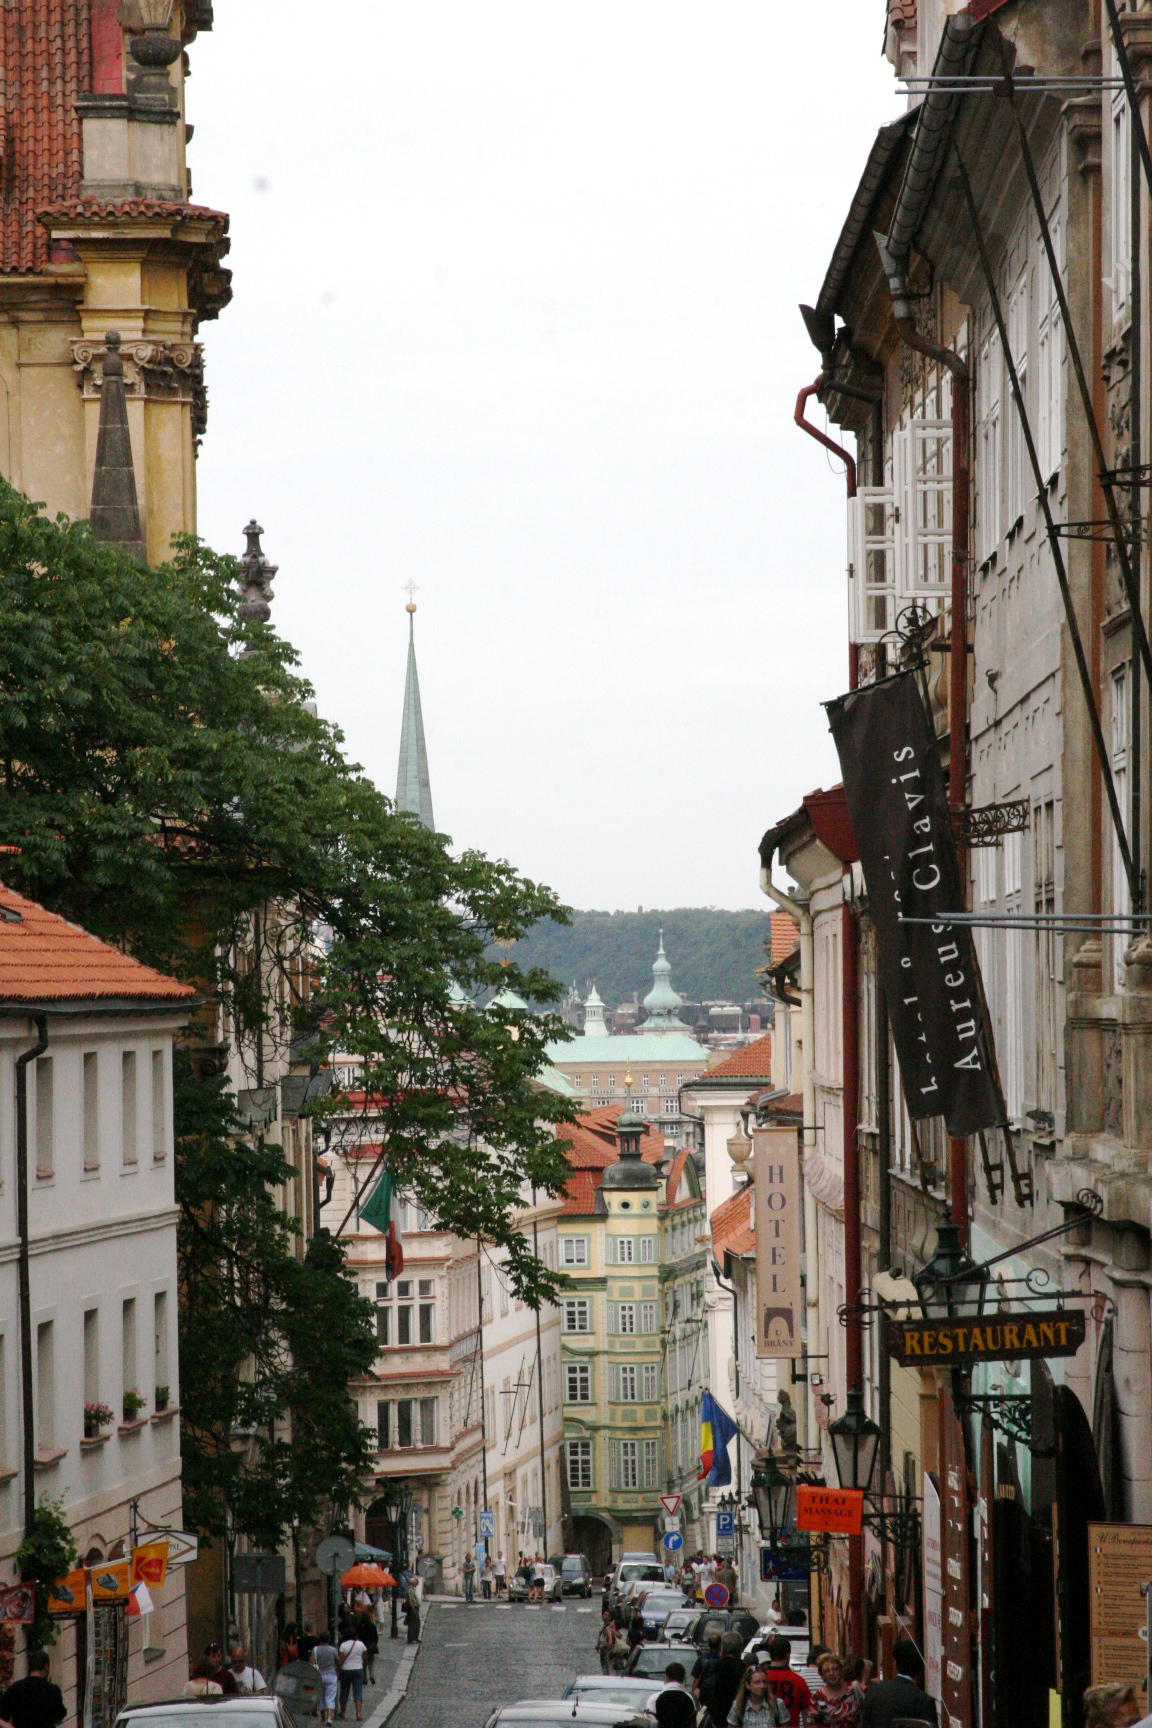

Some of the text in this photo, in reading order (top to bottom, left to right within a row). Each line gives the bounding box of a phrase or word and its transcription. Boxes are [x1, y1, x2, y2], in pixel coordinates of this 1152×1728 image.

[891, 746, 941, 891] Clavis
[931, 922, 982, 1071] Aureus
[767, 1165, 787, 1293] HOTEL
[775, 1329, 782, 1337] U
[904, 1321, 1070, 1355] RESTAURANT
[764, 1339, 794, 1347] BRÁNY
[809, 1495, 847, 1506] THAI
[803, 1506, 855, 1518] MASSAGE
[720, 1514, 731, 1530] P
